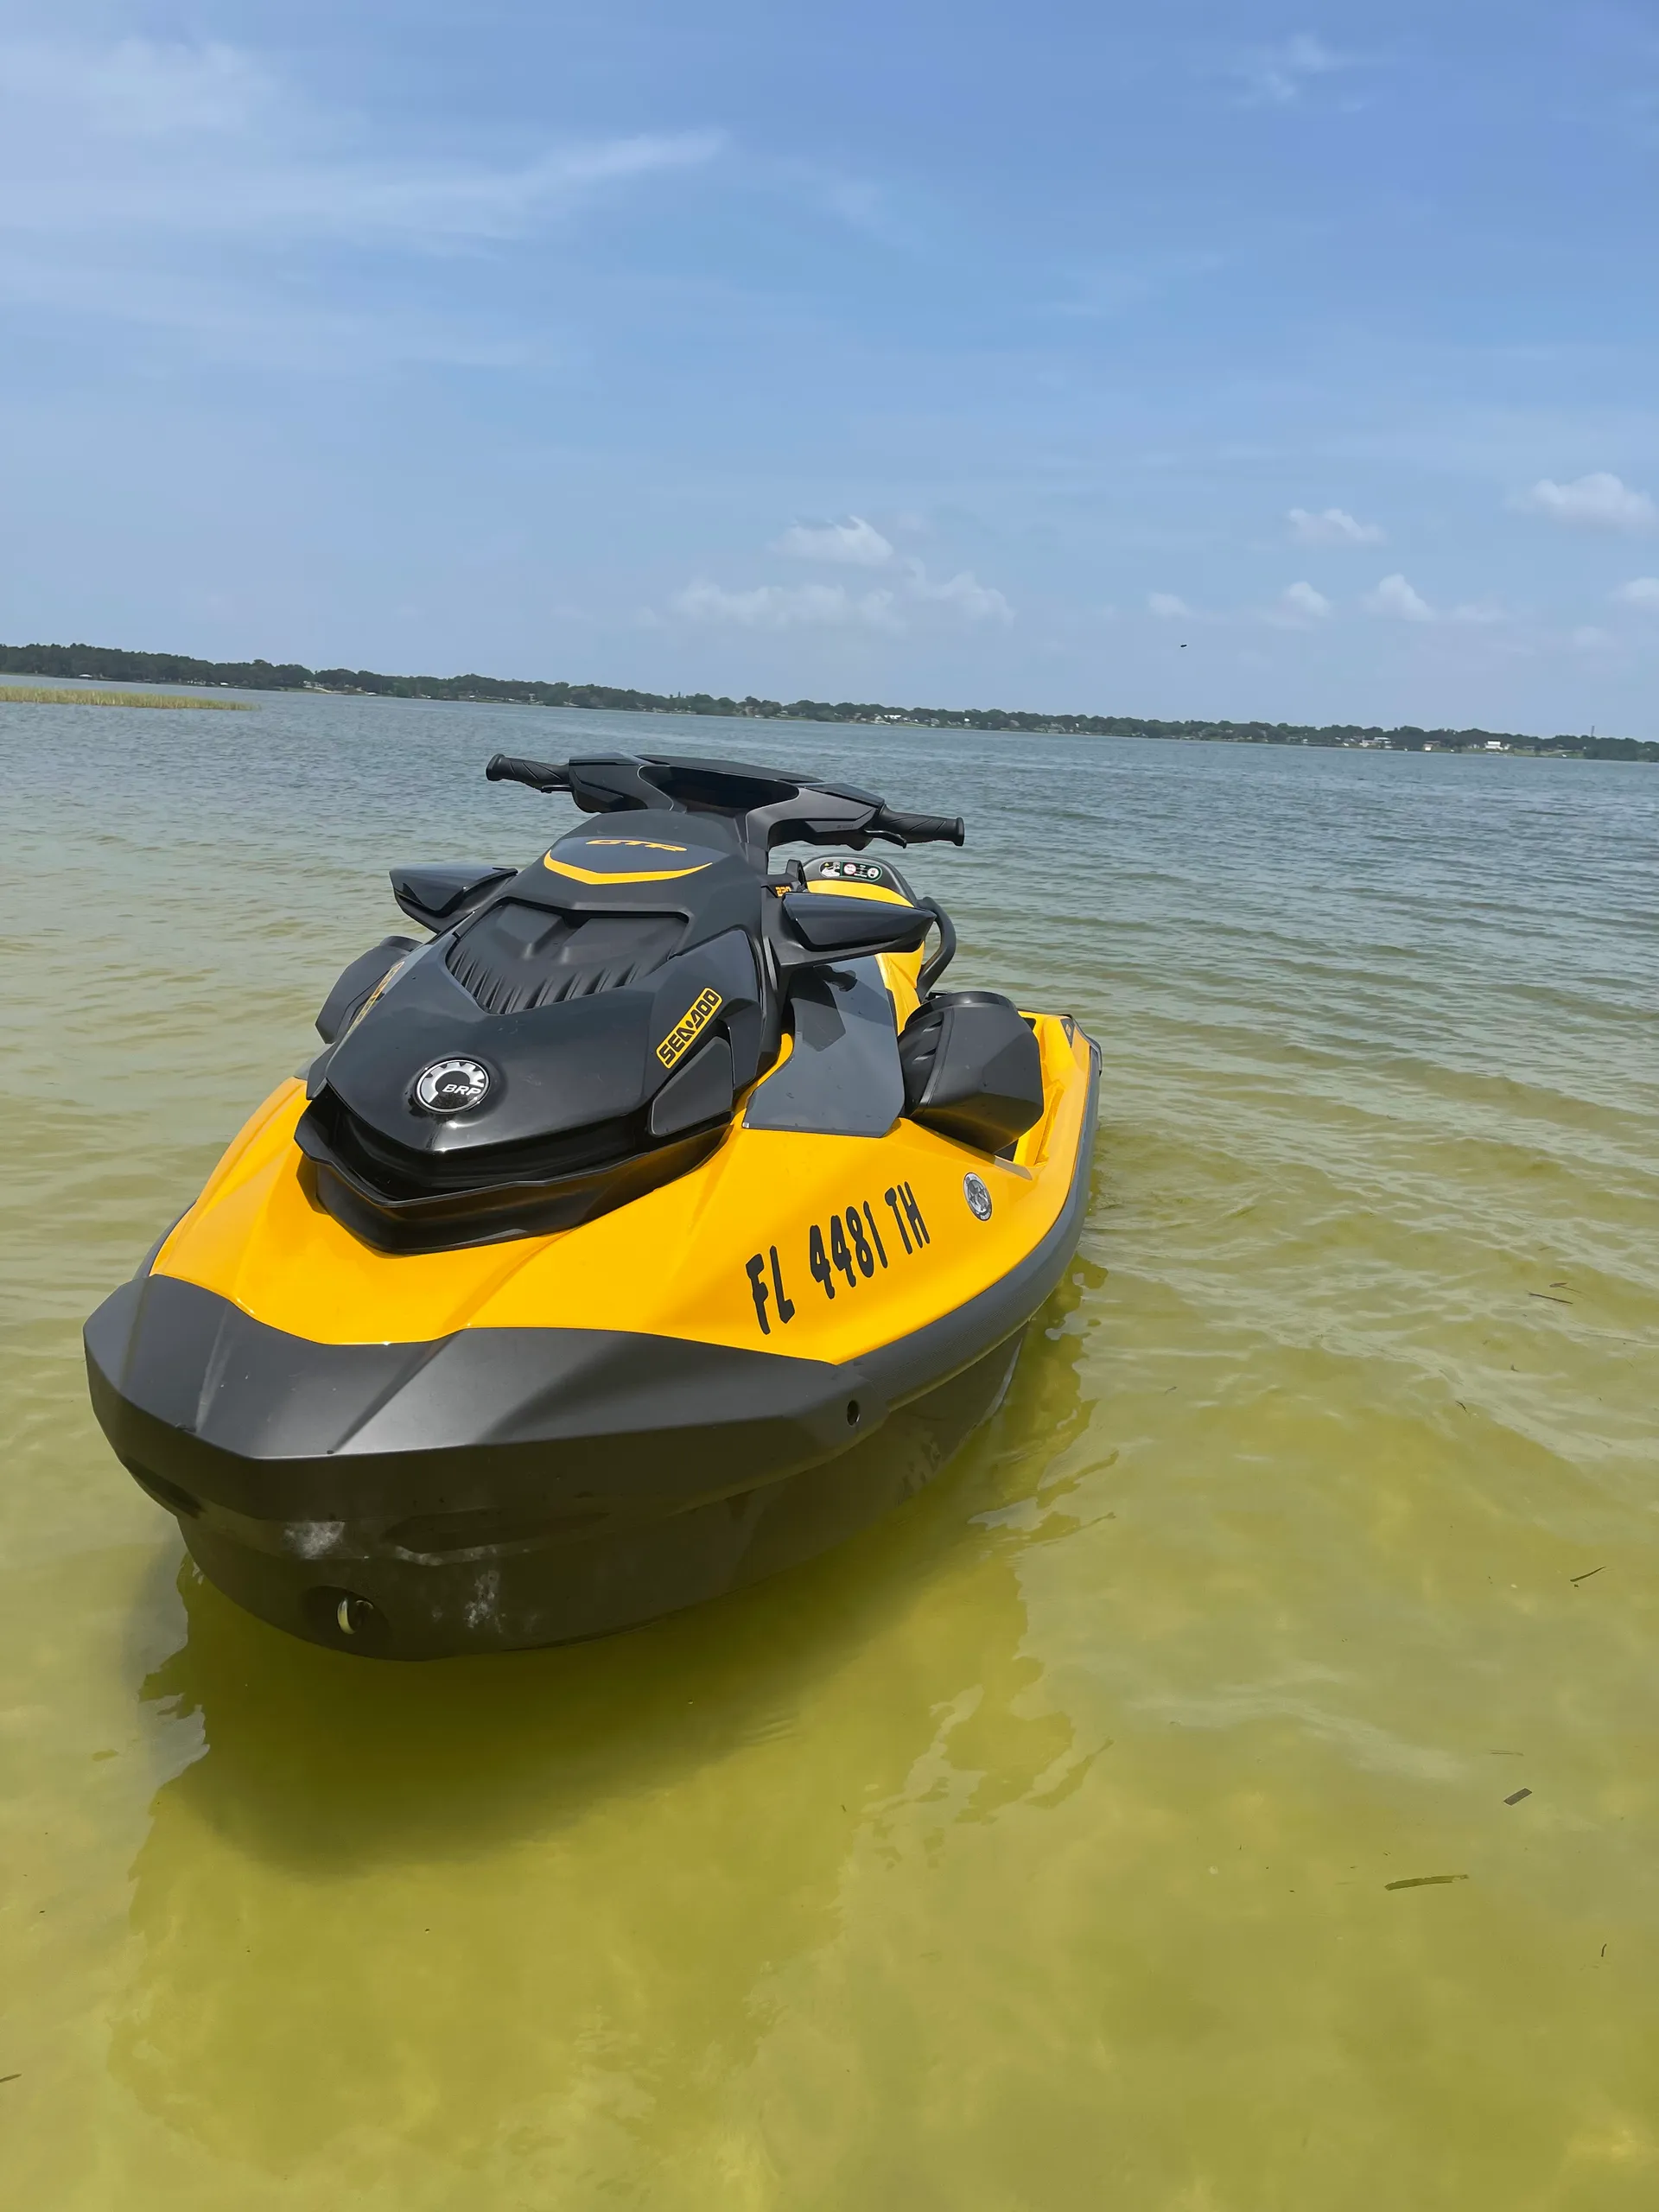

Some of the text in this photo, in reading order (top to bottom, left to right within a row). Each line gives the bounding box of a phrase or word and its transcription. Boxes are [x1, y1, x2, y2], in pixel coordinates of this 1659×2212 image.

[586, 839, 687, 851] GTR
[442, 1084, 482, 1096] BRP
[745, 1245, 796, 1336] FL
[809, 1200, 888, 1300] 4481
[884, 1181, 931, 1255] TH
